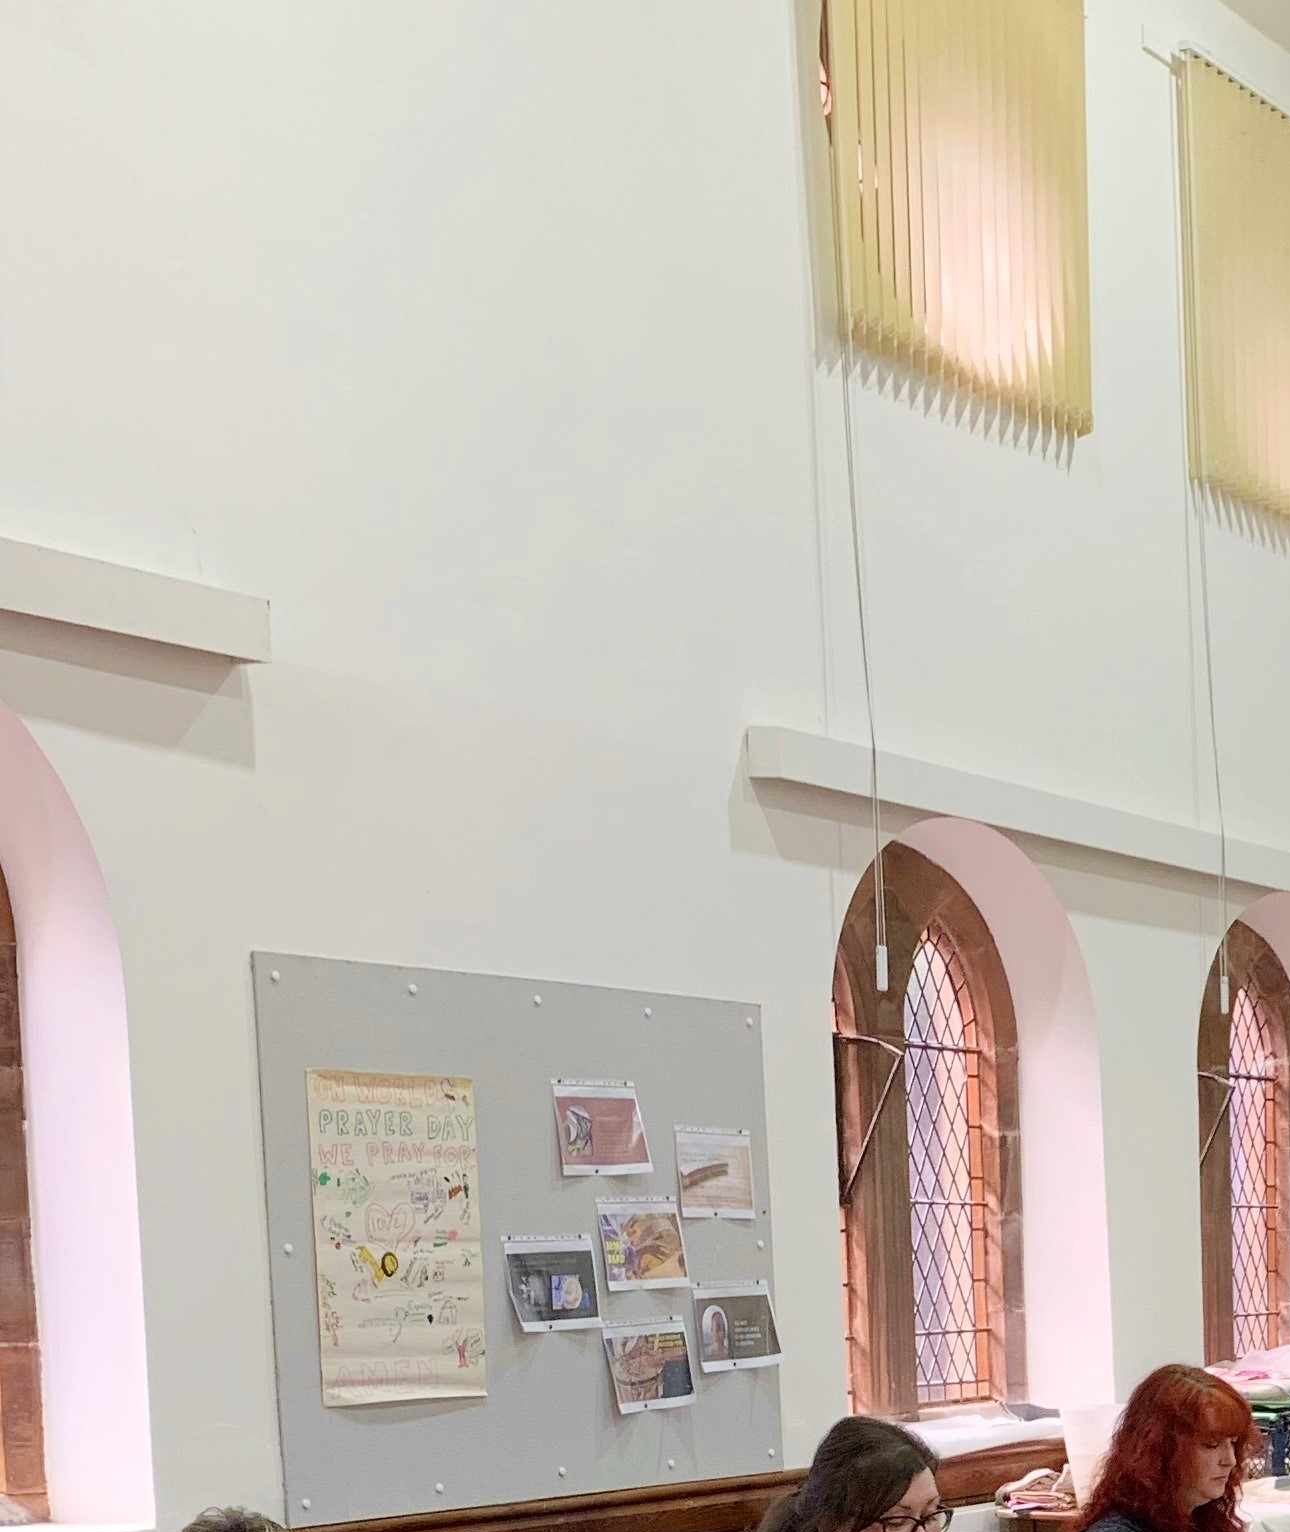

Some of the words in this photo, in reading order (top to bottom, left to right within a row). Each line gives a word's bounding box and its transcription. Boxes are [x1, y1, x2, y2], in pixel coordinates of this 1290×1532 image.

[314, 1073, 345, 1103] ON
[353, 1076, 439, 1108] WORLD
[319, 1108, 413, 1136] PRAYER
[427, 1115, 474, 1142] DAY
[317, 1143, 354, 1166] WE
[366, 1141, 425, 1167] PRAY
[433, 1144, 476, 1170] FOR
[335, 1356, 440, 1396] AMEN
